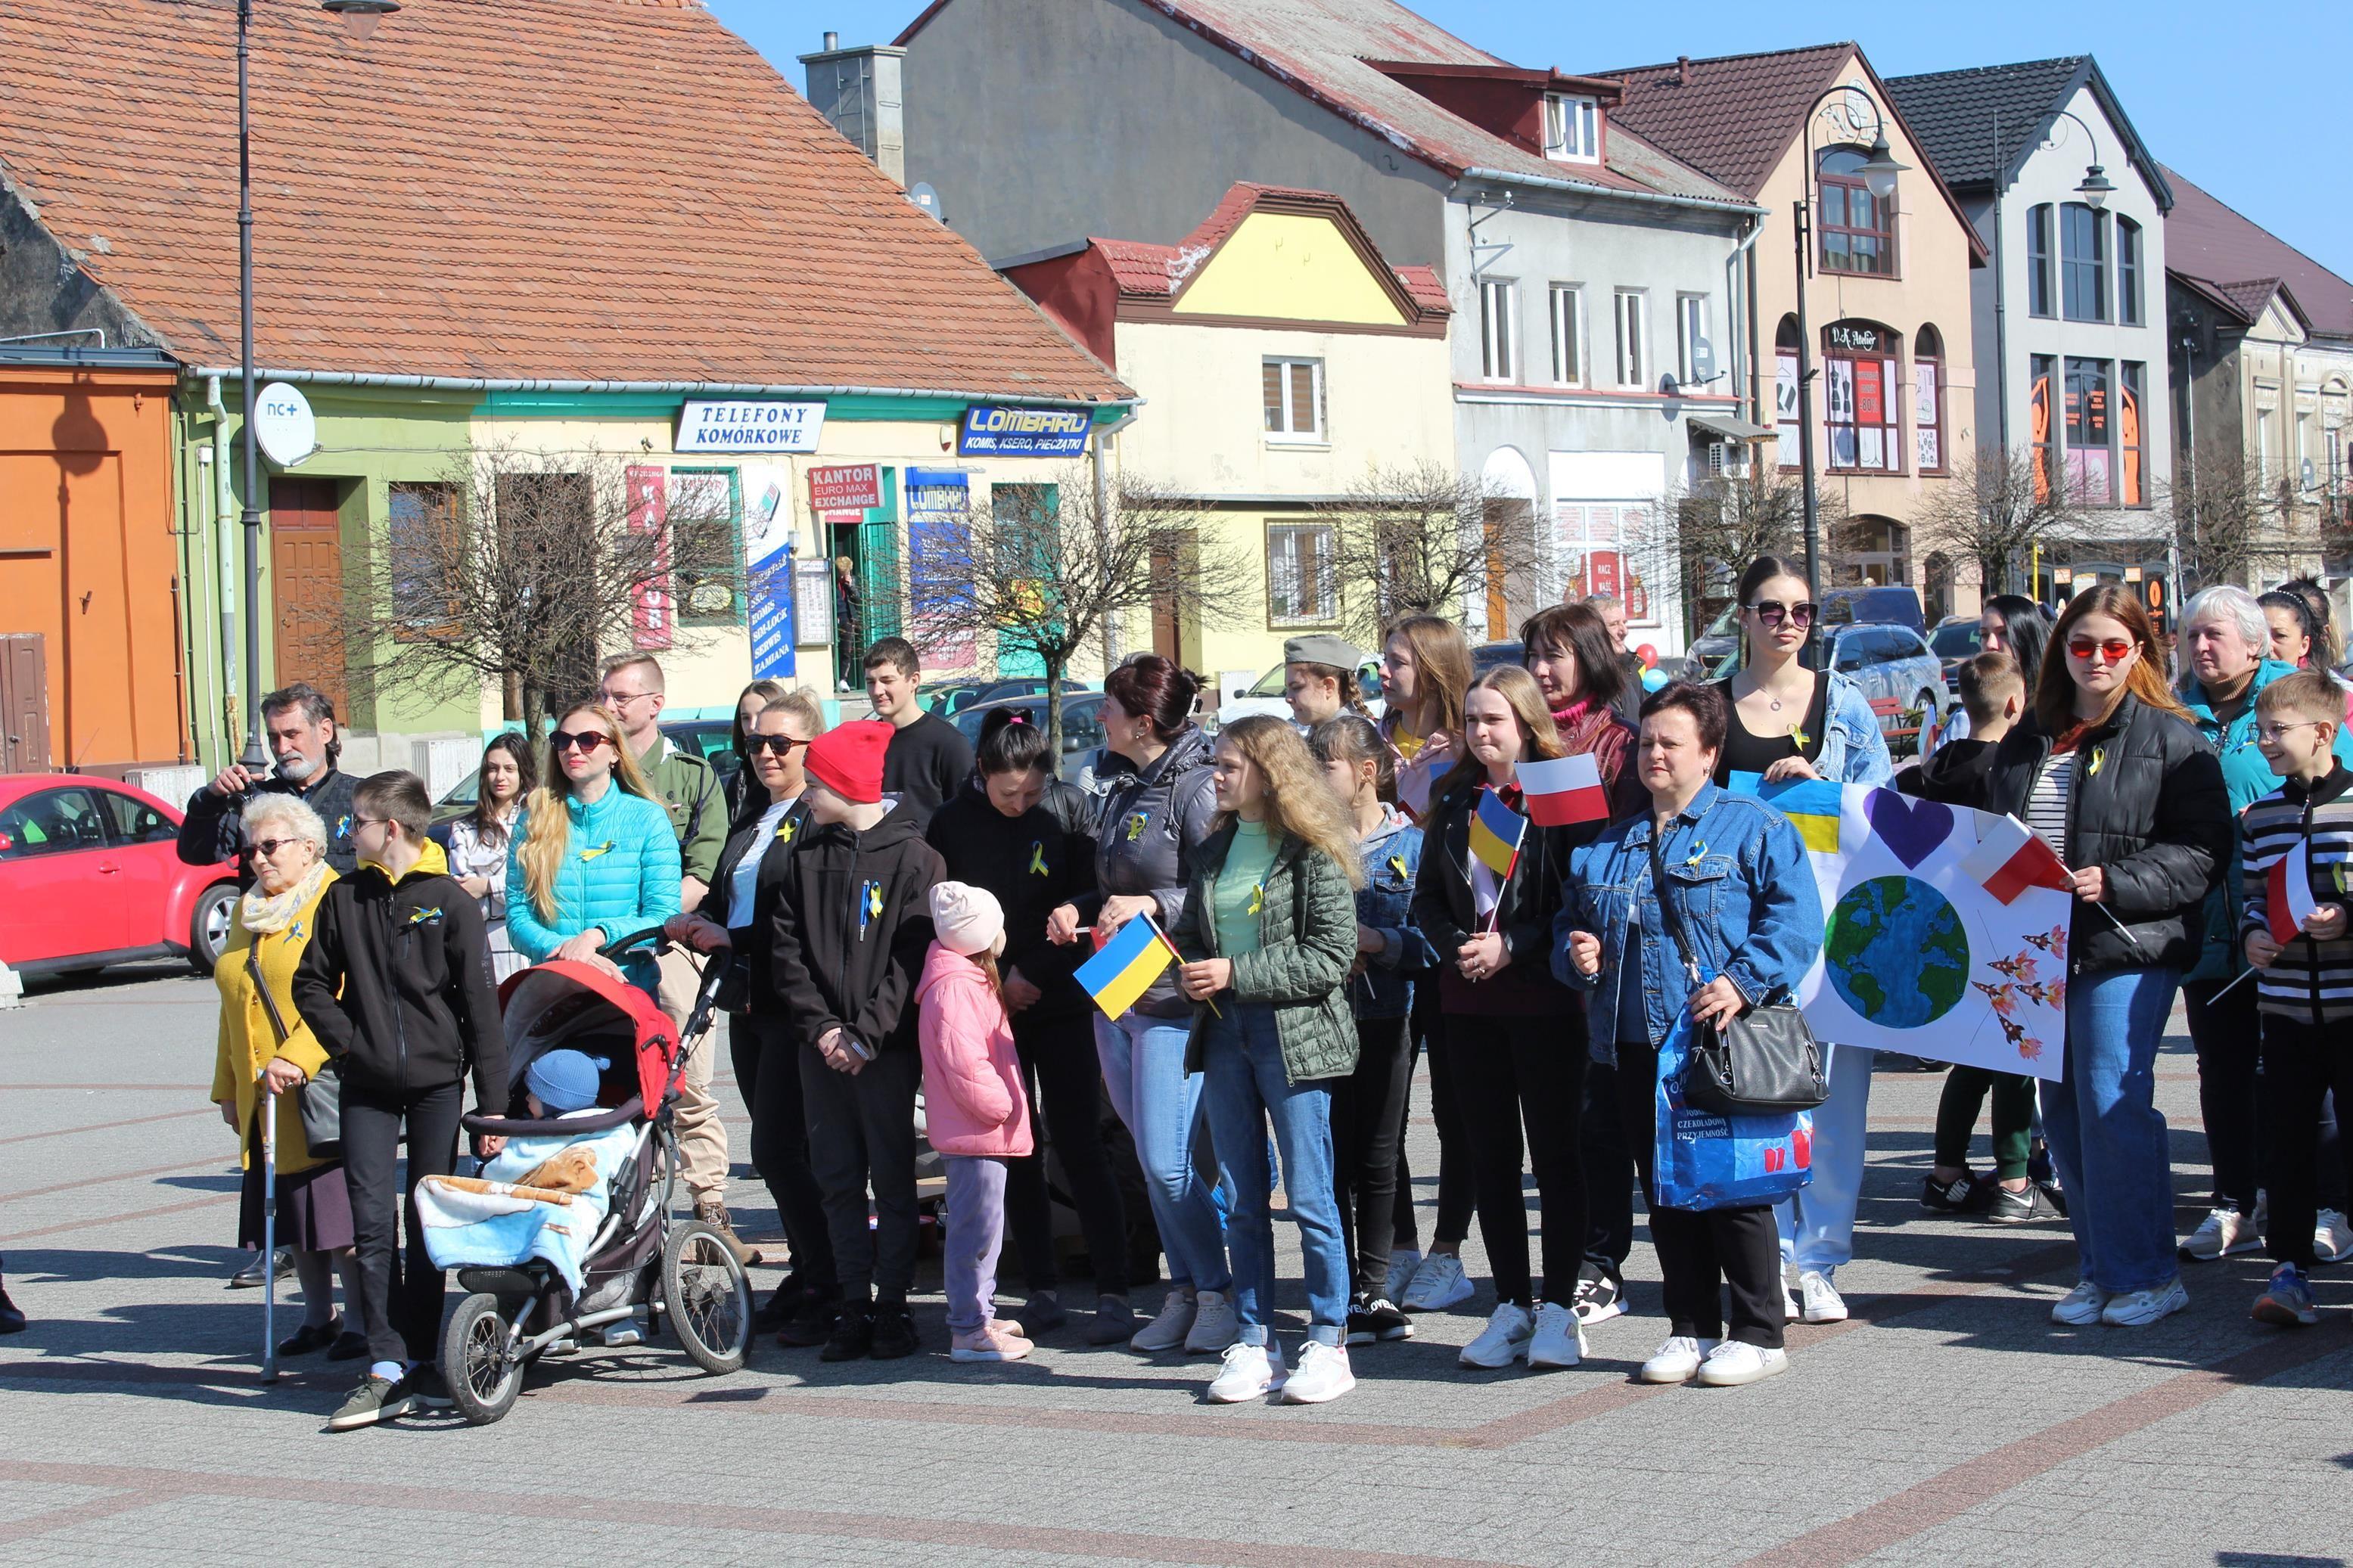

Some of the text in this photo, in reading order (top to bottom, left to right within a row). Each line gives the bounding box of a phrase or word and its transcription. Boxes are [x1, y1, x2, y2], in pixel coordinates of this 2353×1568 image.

[1851, 331, 1876, 352] Atelier
[268, 403, 297, 416] nc+
[701, 408, 808, 424] TELEFONY
[968, 409, 1088, 433] LOMBARD
[696, 427, 803, 445] KOMÓRKOWE
[965, 436, 1083, 452] KOMIS, KSERO, PIECZĄTKI
[813, 467, 873, 485] KANTOR
[814, 483, 868, 495] EURO MAX
[909, 486, 966, 510] LOMBARD
[814, 493, 876, 508] EXCHANGE
[1597, 564, 1612, 575] RACZ
[753, 607, 788, 643] SIM-LOCK
[754, 630, 782, 660] SERWIS
[754, 643, 790, 674] ZAMIANA
[1677, 1128, 1730, 1141] PRZYJEMNOŚĆ
